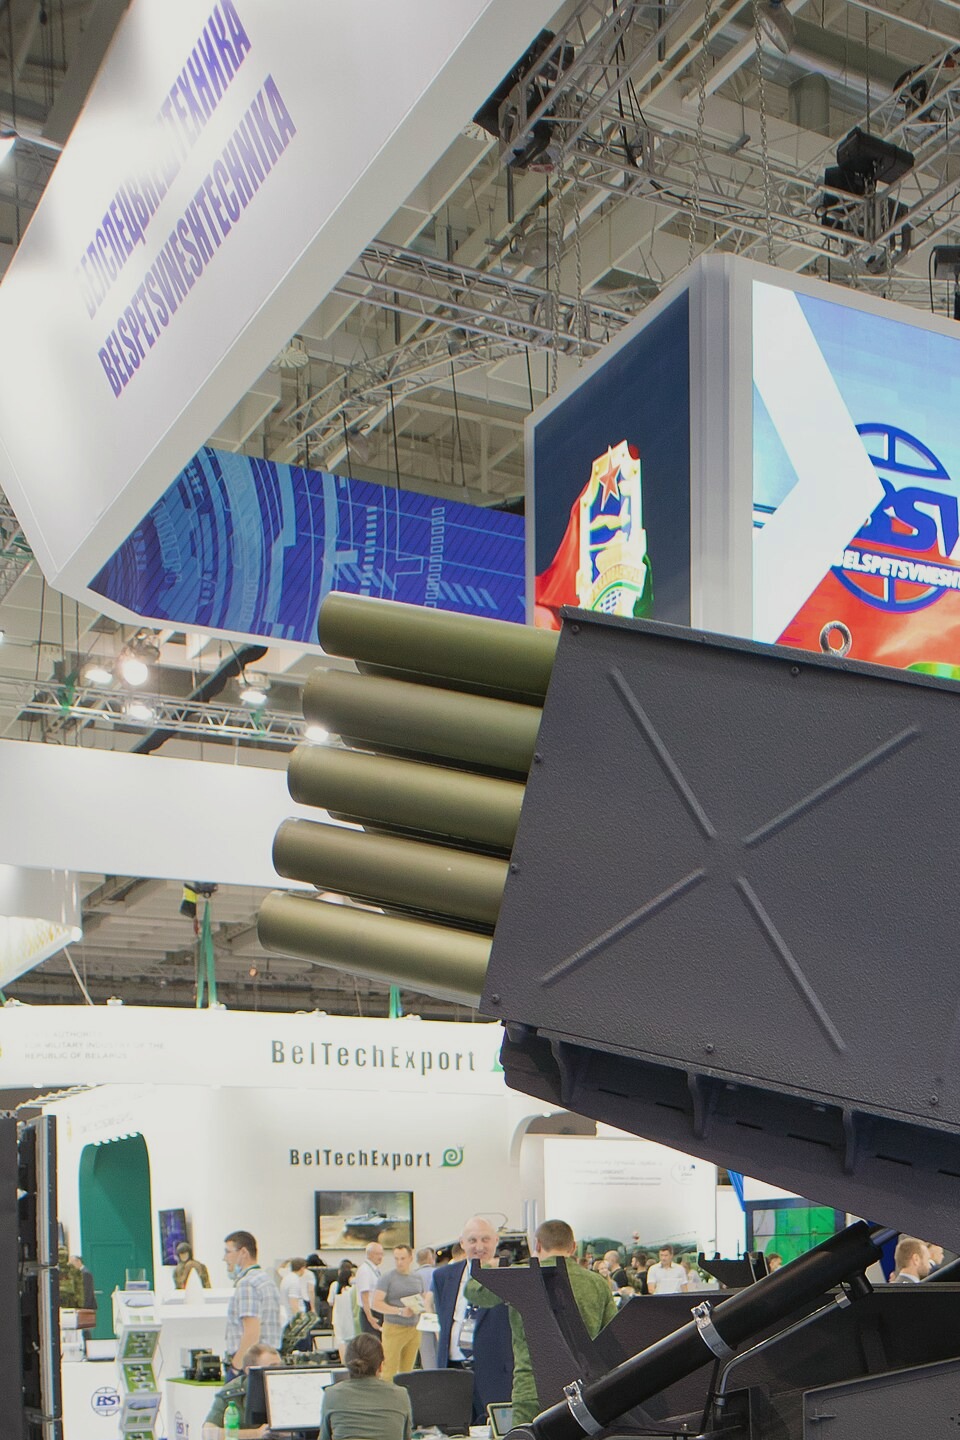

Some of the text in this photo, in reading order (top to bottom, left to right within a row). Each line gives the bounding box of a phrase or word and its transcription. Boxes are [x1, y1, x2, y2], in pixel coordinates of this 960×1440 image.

[98, 73, 297, 399] BELSPETSVNESHTECHNIKA
[271, 1040, 475, 1075] BelTechExport
[289, 1149, 431, 1171] BelTechExport
